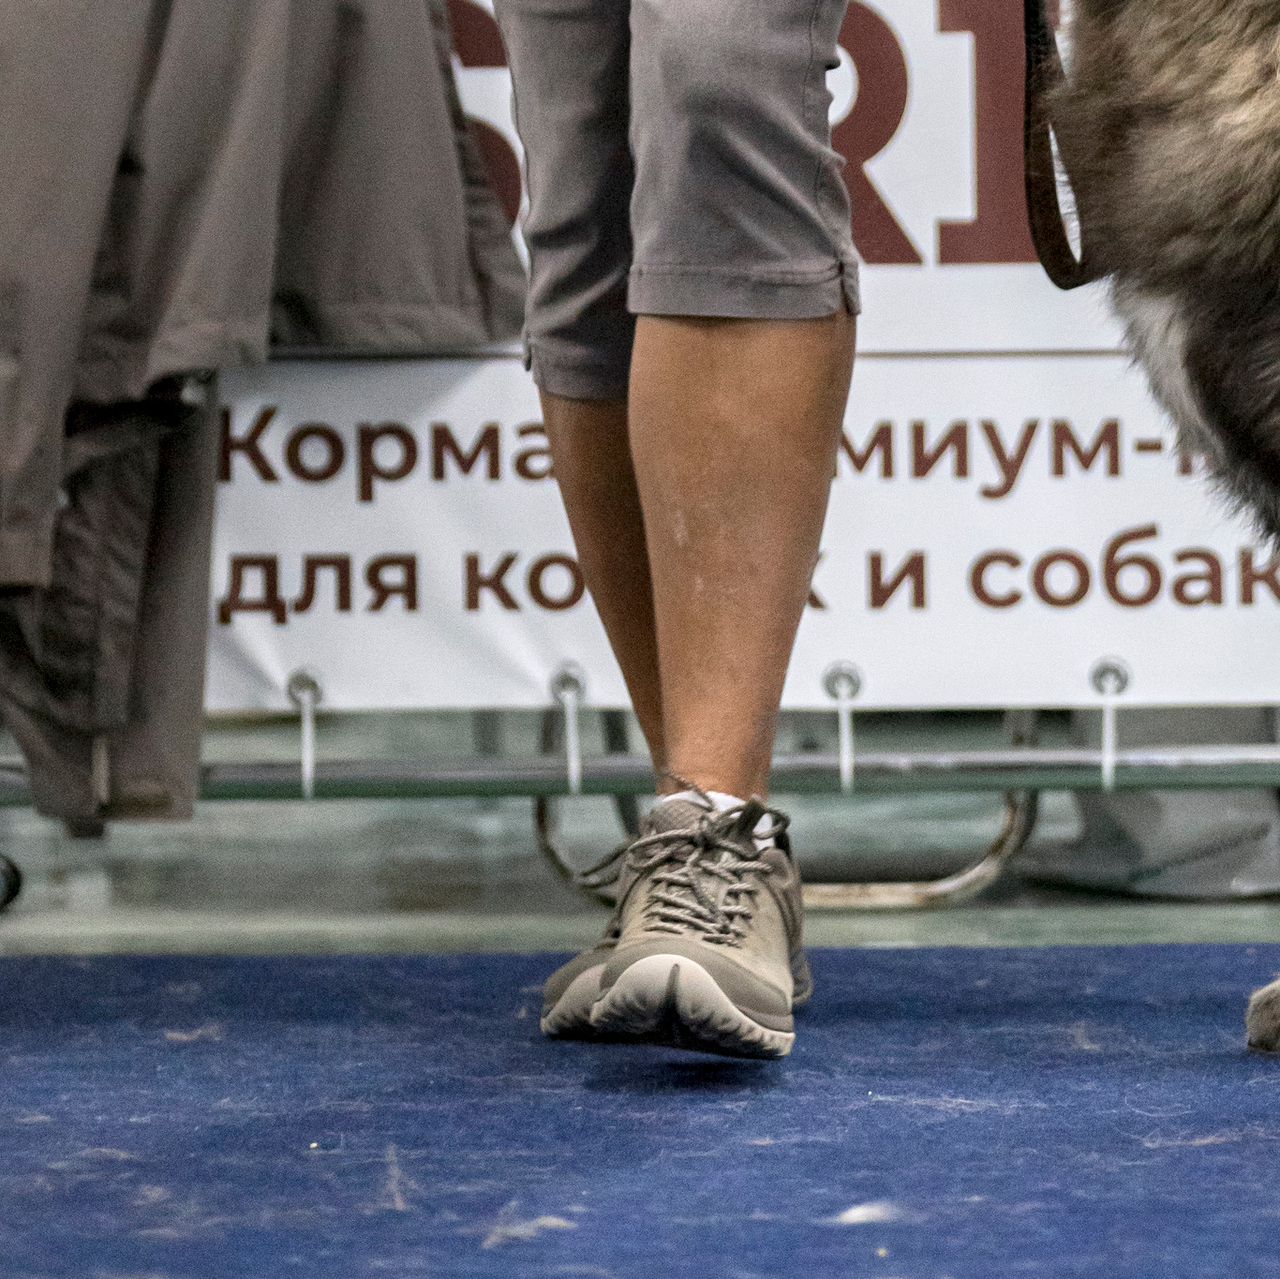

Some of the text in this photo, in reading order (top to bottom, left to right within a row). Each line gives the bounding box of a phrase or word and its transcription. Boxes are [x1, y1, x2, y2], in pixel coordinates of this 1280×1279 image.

[217, 404, 555, 504] Корма
[217, 551, 420, 626] для
[866, 549, 927, 610] и
